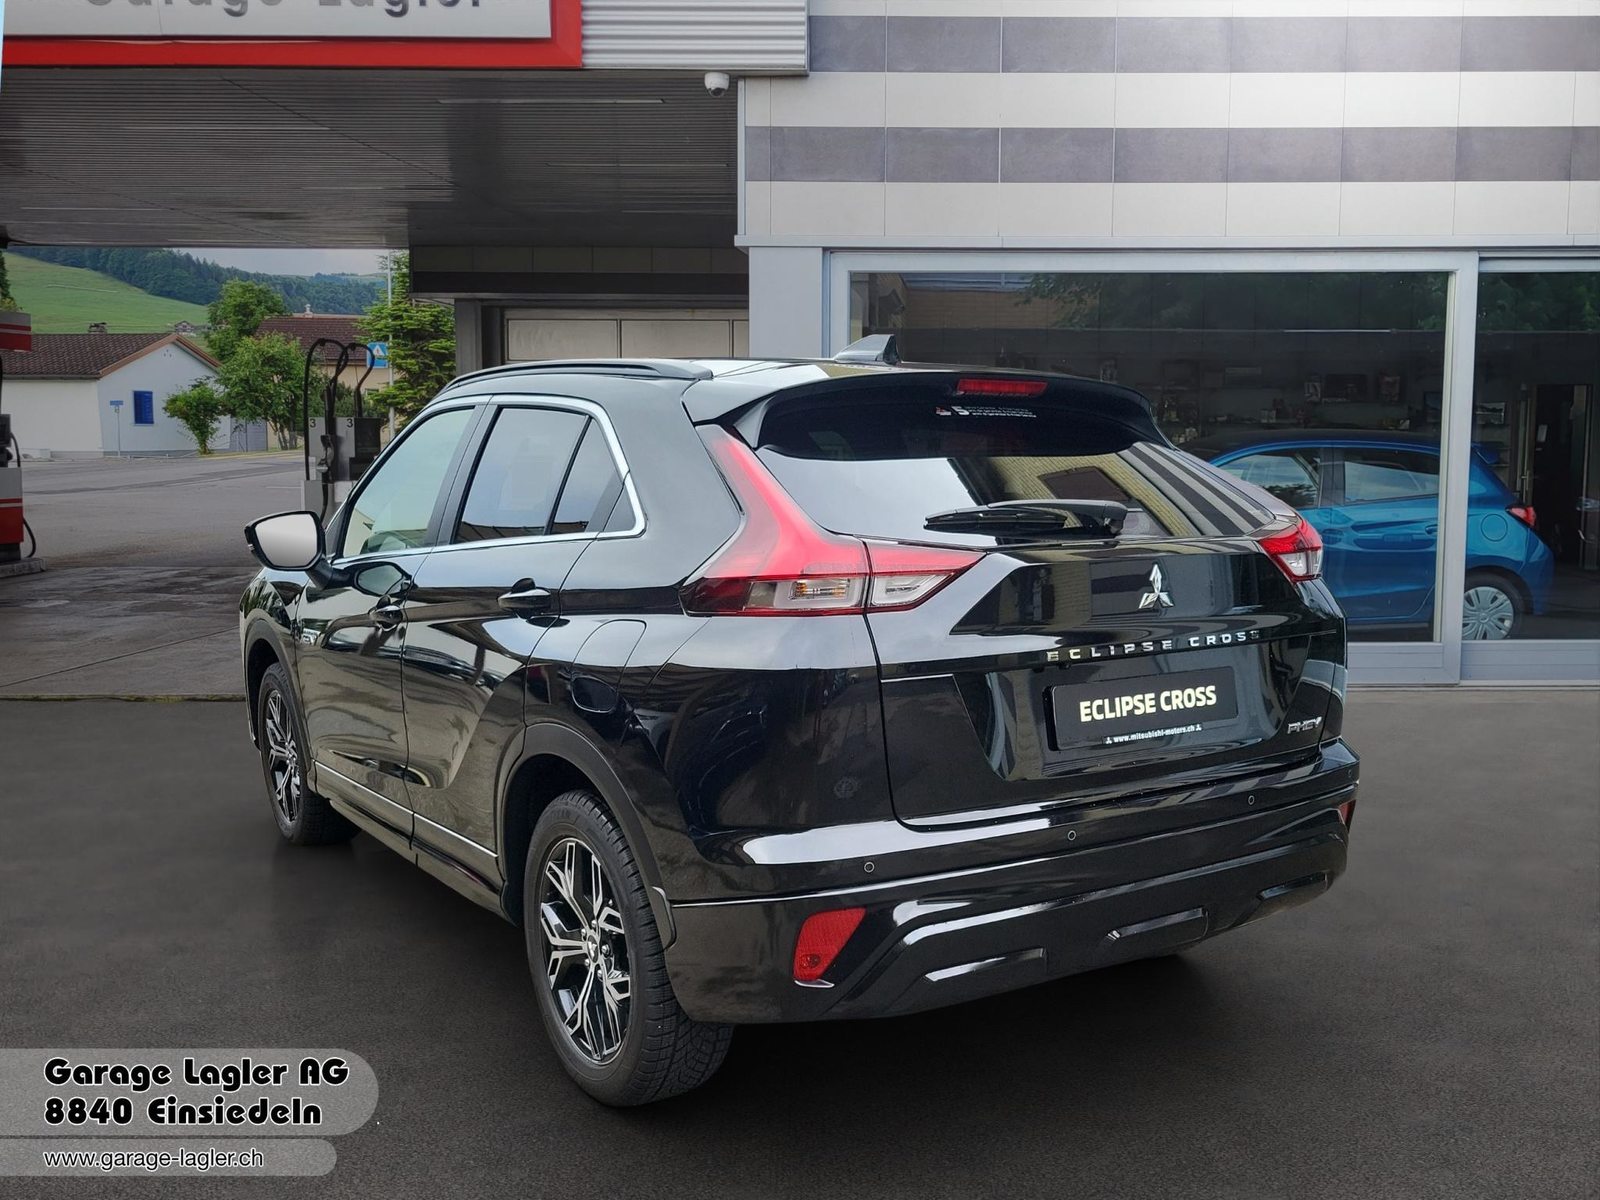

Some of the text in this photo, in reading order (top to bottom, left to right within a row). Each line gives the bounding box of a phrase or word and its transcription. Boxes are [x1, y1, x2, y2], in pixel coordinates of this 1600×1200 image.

[309, 418, 316, 428] 3
[346, 418, 354, 428] 3
[1046, 630, 1259, 662] ECLIPSE CROSS
[1079, 685, 1217, 723] ECLIPSE CROSS
[1113, 724, 1195, 743] www.mitsubishi-motors.ch
